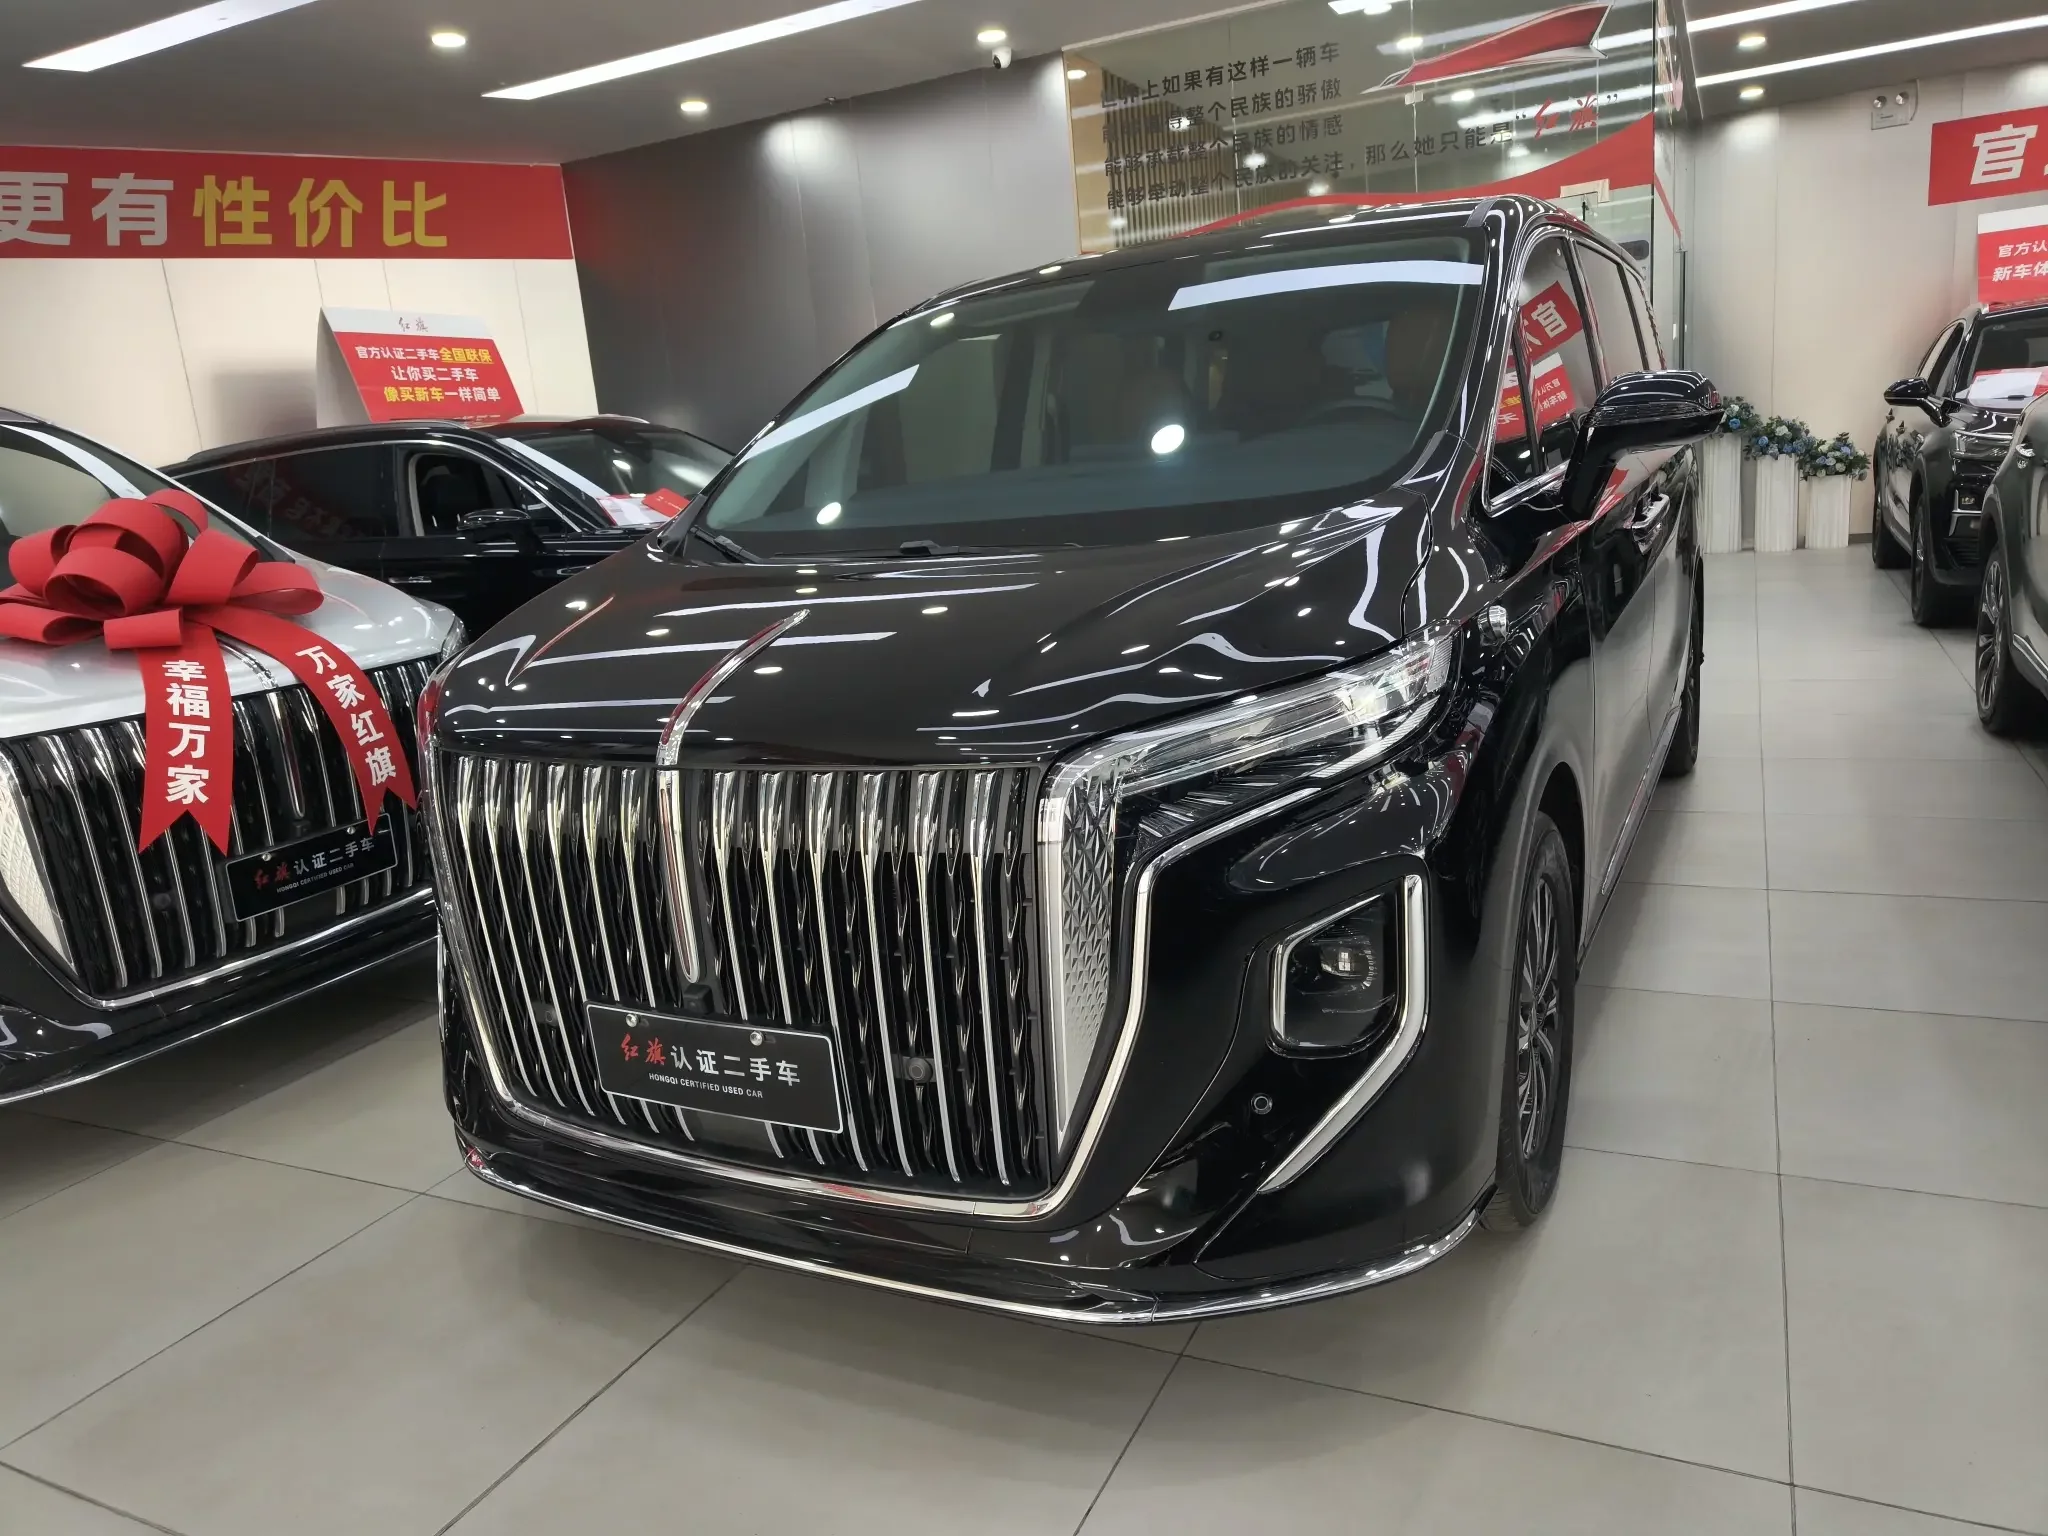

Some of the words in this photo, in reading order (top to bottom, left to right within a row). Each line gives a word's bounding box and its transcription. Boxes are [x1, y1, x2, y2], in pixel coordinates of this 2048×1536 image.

[1102, 77, 1342, 143] 得整个民族的骄傲
[1970, 124, 2048, 186] 官
[0, 171, 447, 248] 更有性价比
[1998, 239, 2048, 258] 官方认
[1992, 260, 2048, 282] 新车体
[398, 316, 429, 333] 红旗
[355, 346, 492, 362] 官方认证二手车全国联保
[391, 366, 479, 382] 让你买二手车
[383, 386, 501, 402] 像买新车一样简单
[295, 645, 396, 786] 万家红旗
[162, 660, 211, 805] 幸福万家
[254, 837, 375, 890] 红旗认证二手车
[277, 882, 299, 893] HONGQI
[300, 872, 328, 885] CERTIFIED
[328, 866, 343, 876] USED
[620, 1033, 801, 1087] 红旗认证二手车
[649, 1073, 678, 1086] HONGQI
[680, 1078, 720, 1093] CERTIFIED
[722, 1085, 744, 1096] USED
[746, 1088, 763, 1099] CAR
